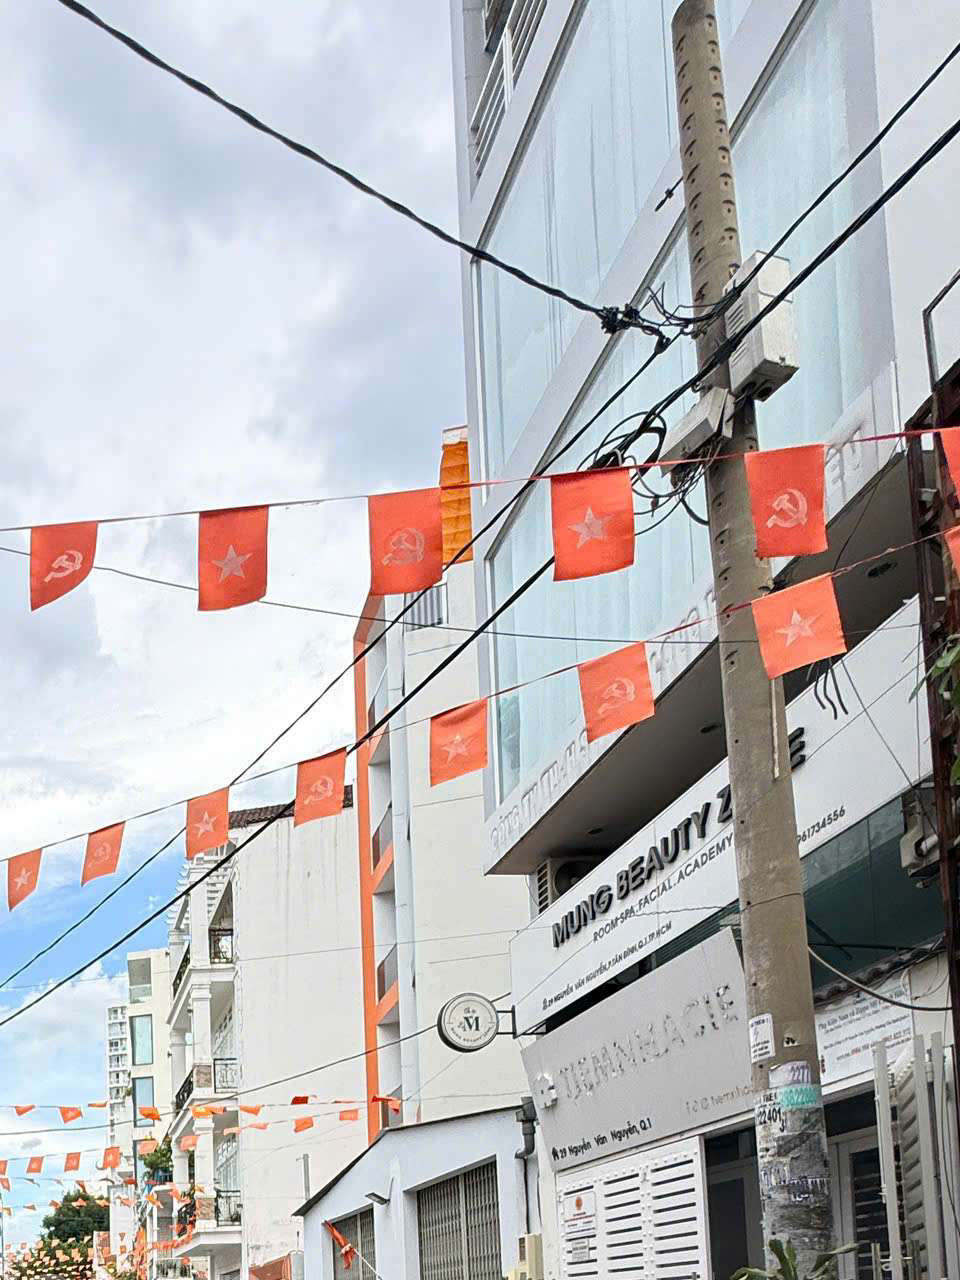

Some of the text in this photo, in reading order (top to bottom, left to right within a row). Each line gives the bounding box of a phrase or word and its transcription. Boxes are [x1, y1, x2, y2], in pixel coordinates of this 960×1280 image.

[796, 805, 846, 846] 961734556
[551, 885, 613, 949] MUNG
[616, 802, 712, 900] BEAUTY
[559, 1147, 567, 1159] 29
